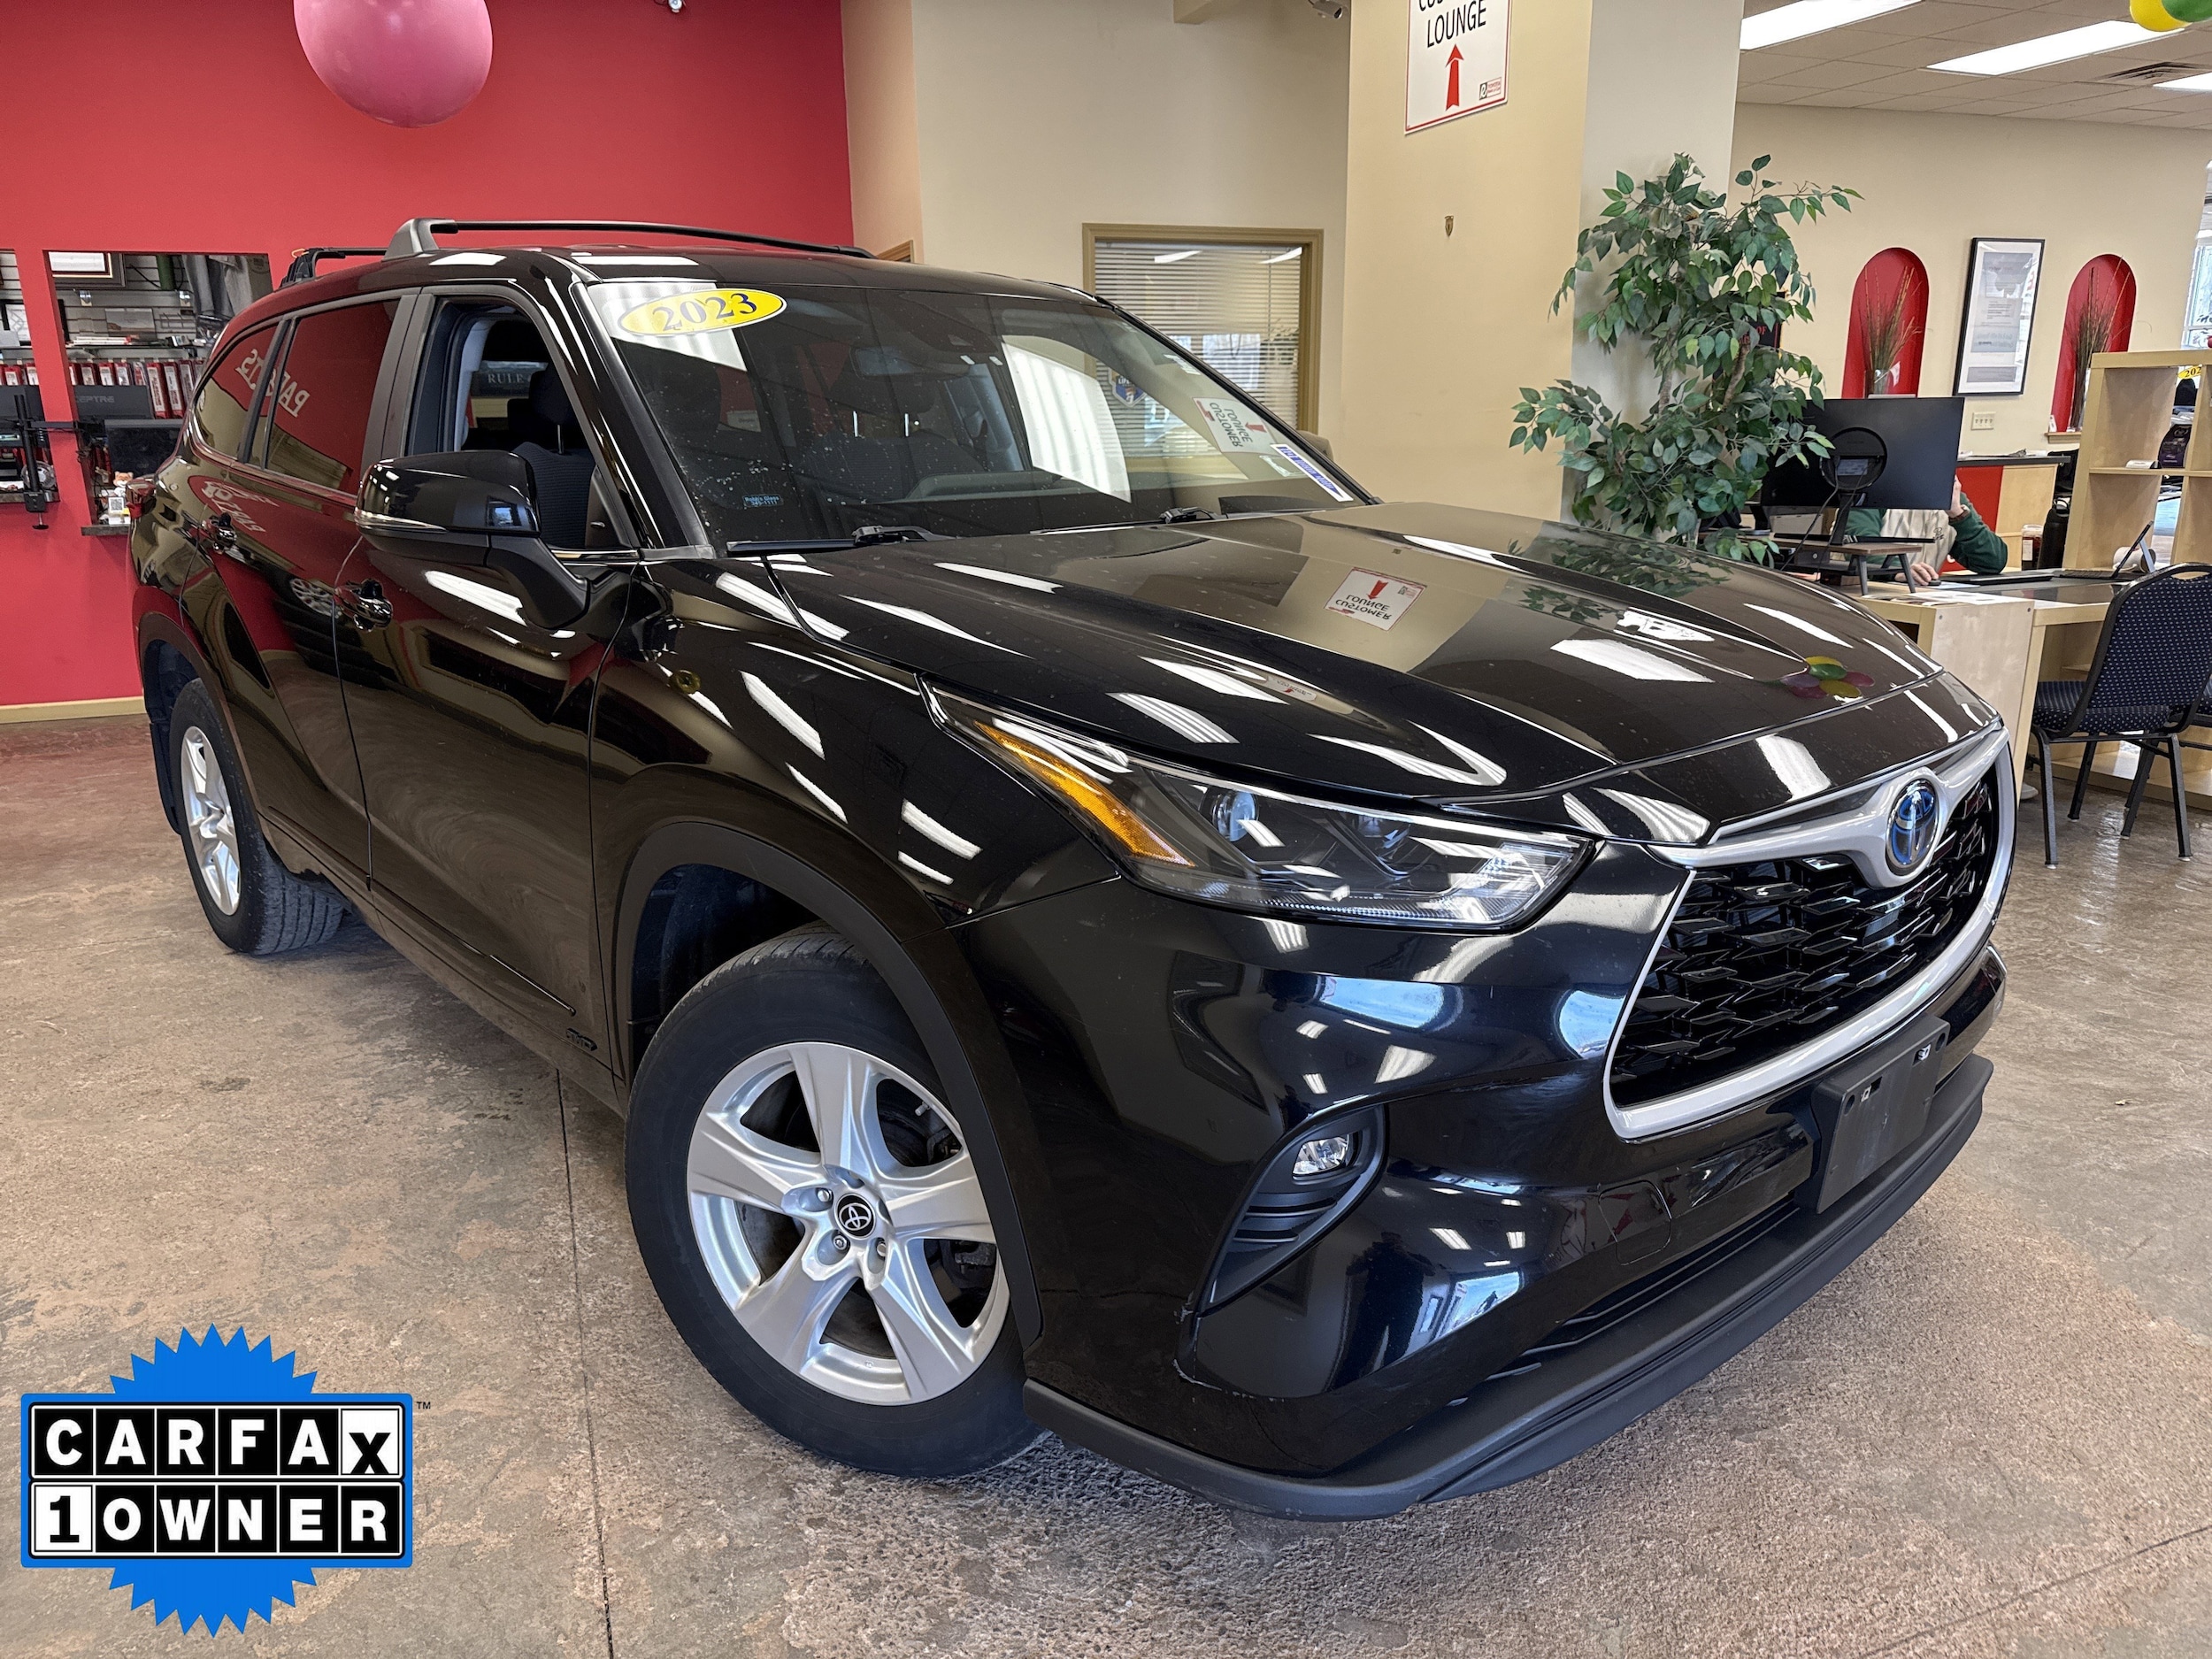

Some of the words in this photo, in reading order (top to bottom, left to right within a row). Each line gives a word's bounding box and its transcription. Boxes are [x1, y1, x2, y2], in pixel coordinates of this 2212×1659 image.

[1427, 0, 1486, 48] LOUNGE
[652, 293, 757, 331] 2023
[2185, 366, 2201, 377] 202
